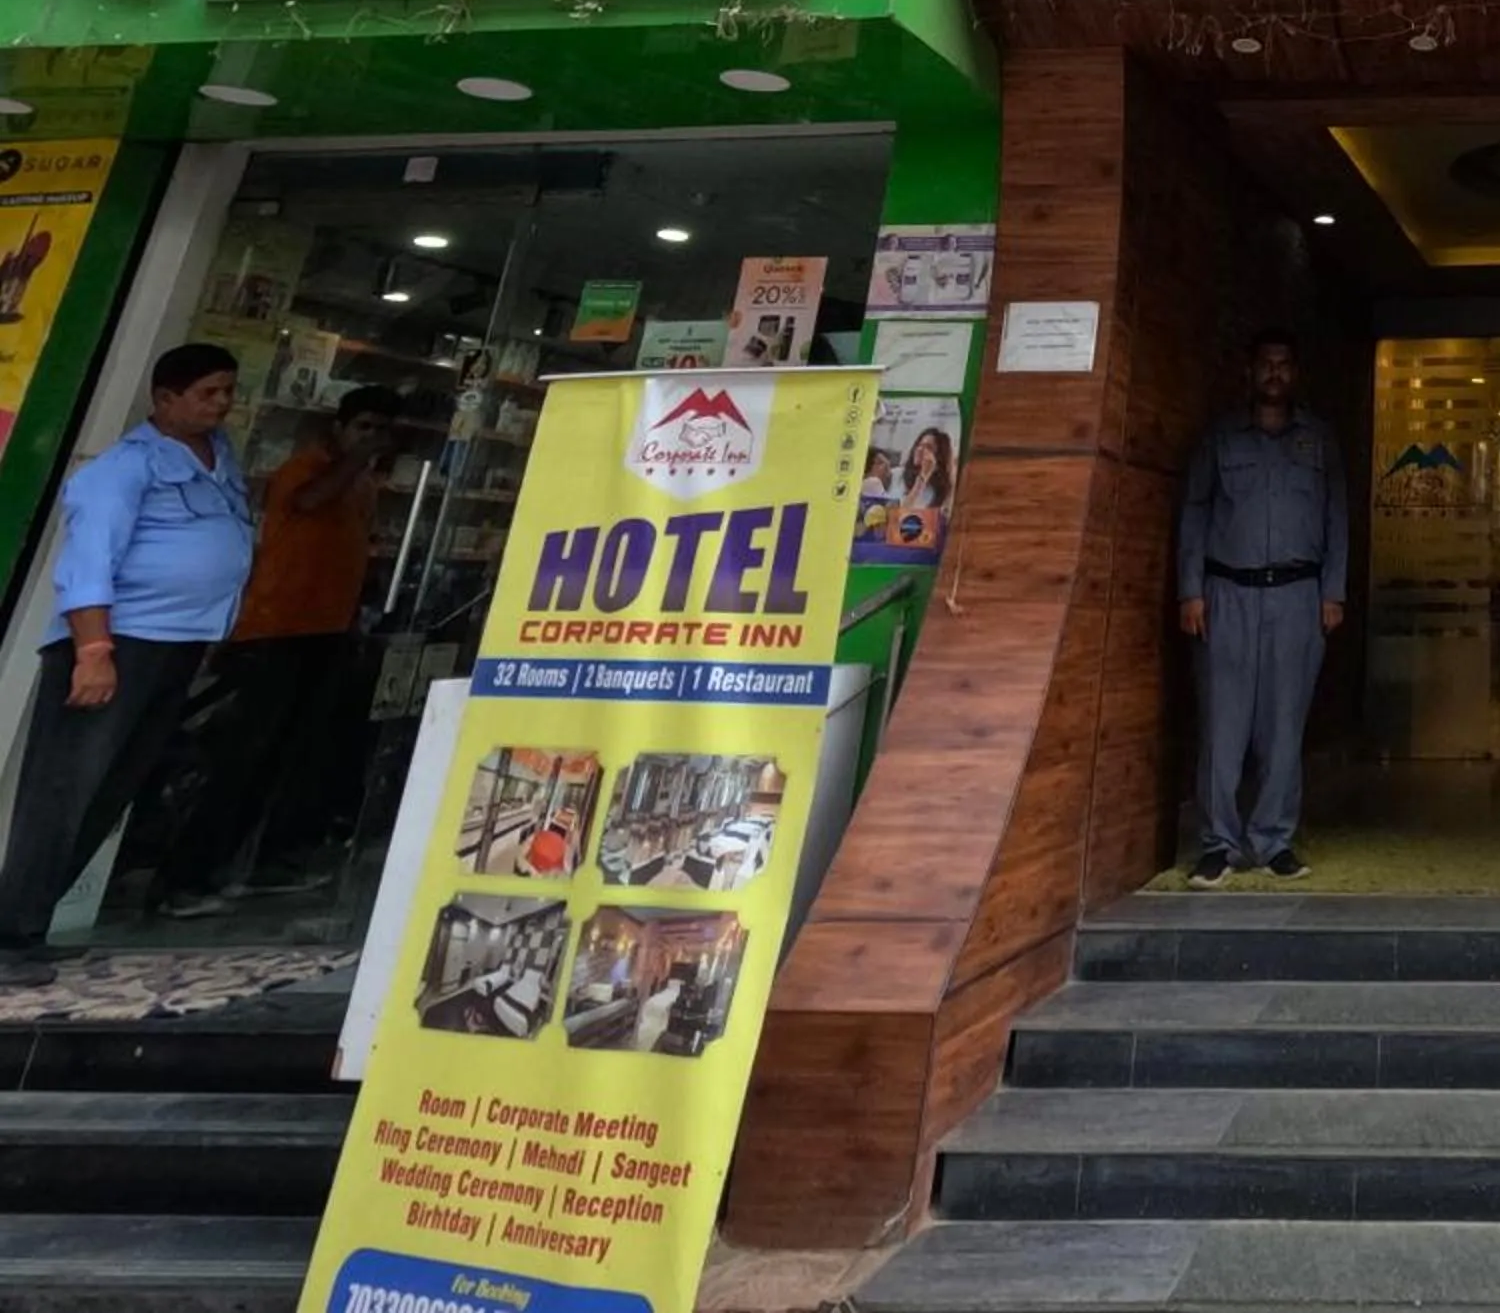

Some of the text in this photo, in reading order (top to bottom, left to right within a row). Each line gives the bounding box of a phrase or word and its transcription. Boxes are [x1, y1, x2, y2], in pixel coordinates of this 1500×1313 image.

[641, 440, 717, 466] Corporate
[527, 503, 809, 615] HOTEL
[519, 620, 803, 648] CORPORATE INN
[493, 662, 815, 695] 32 Rooms 2 Banquets 1 Restaurant
[419, 1089, 659, 1148] Room Corporate Meeting
[374, 1119, 693, 1189] Ring Ceremony Mehndi Sangeet
[380, 1157, 665, 1224] Wedding Ceremony Reception
[502, 1215, 612, 1264] Anniversary
